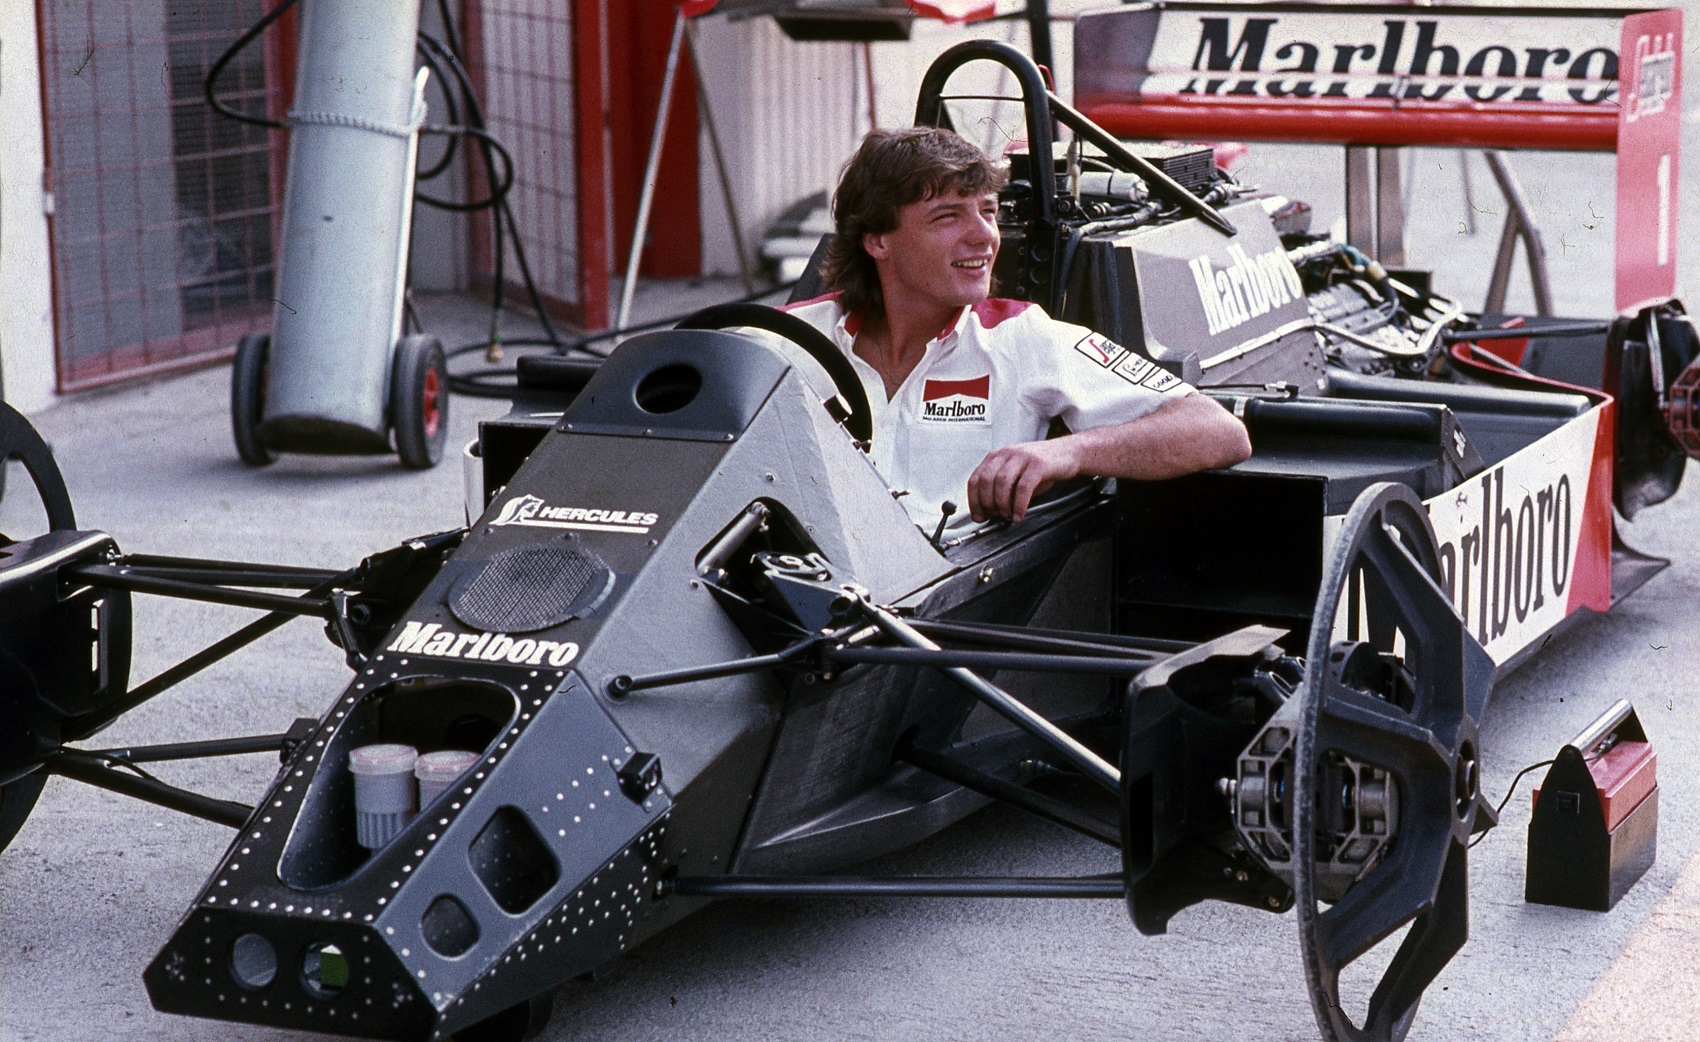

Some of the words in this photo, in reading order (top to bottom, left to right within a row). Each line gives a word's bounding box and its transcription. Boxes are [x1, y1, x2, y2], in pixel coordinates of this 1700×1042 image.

[1179, 17, 1619, 104] Marlboro
[1657, 153, 1671, 268] 1
[1188, 242, 1301, 336] Marlboro
[924, 400, 986, 417] Marlboro
[539, 505, 659, 526] HERCULES
[387, 621, 580, 667] Marlboro
